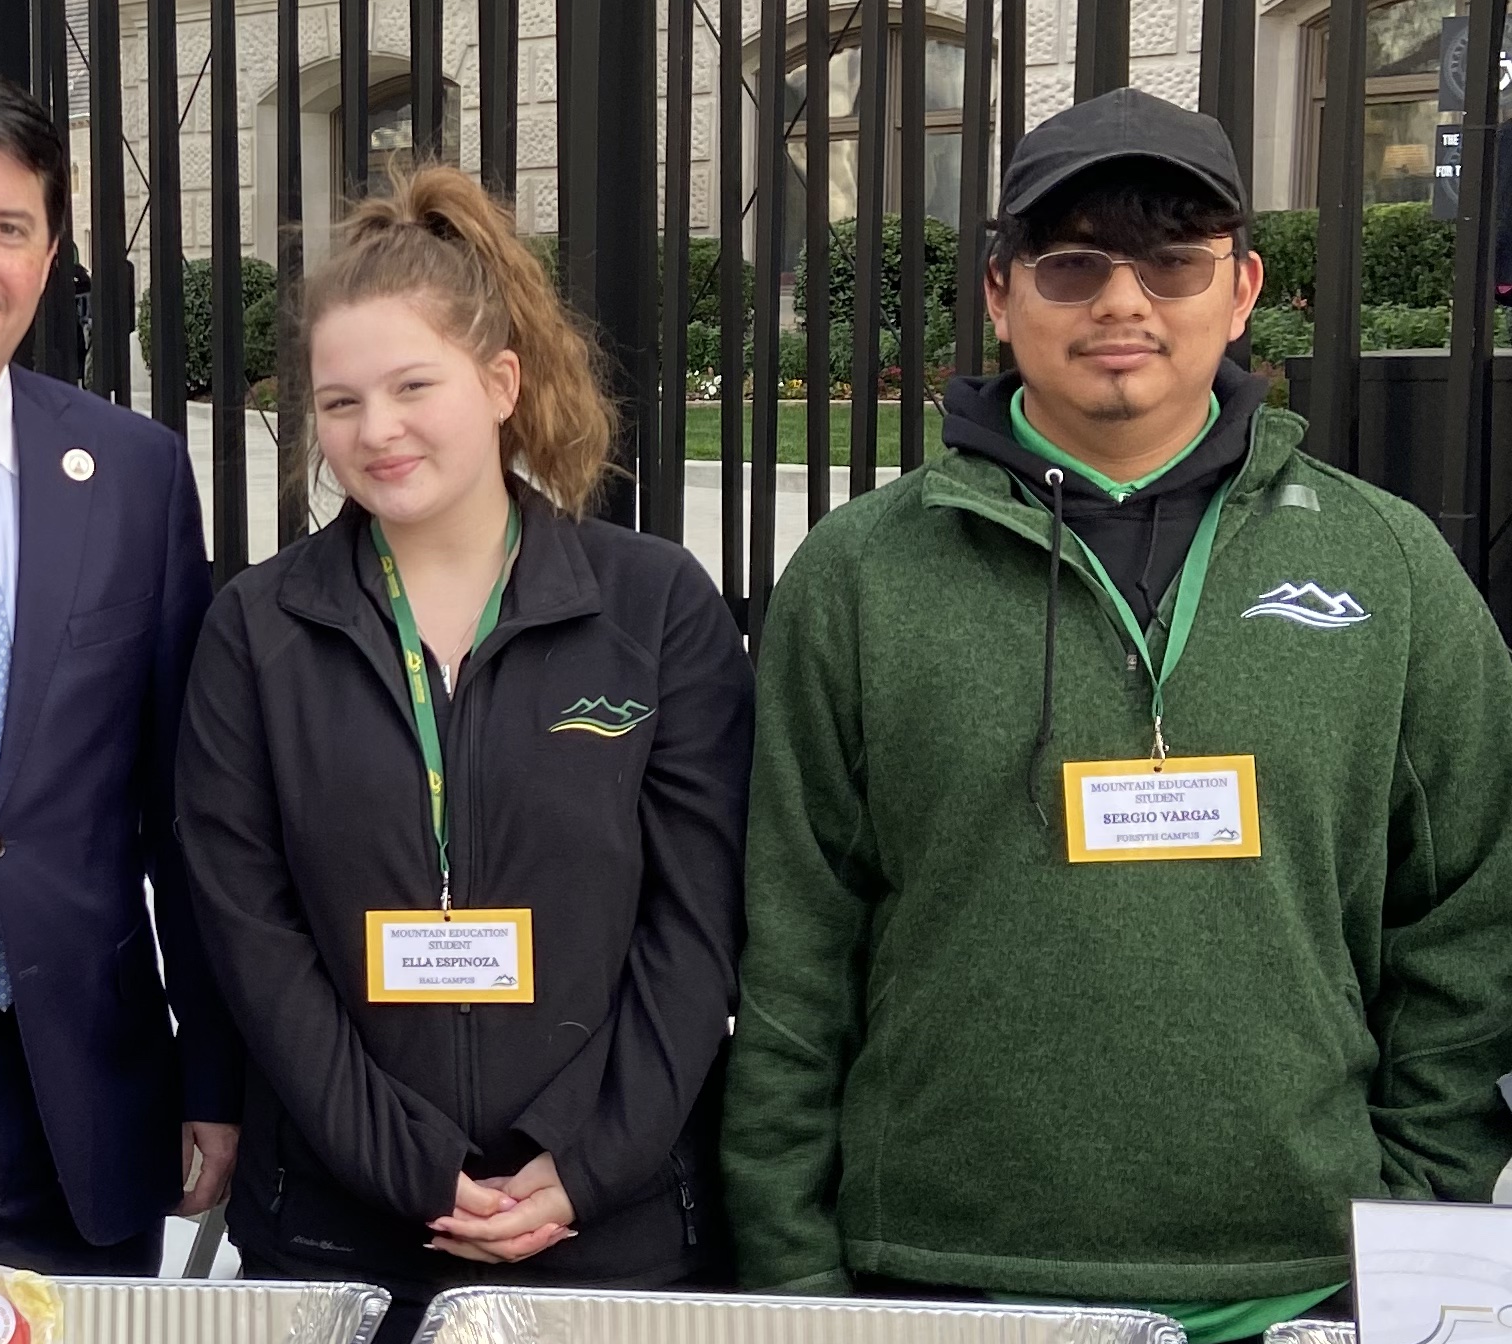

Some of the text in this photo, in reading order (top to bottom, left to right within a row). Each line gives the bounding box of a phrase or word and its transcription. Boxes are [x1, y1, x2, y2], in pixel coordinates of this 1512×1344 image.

[1091, 778, 1228, 793] MOUNTAIN EDUCATION
[1135, 792, 1185, 805] STUDENT
[1103, 809, 1220, 824] SERGIO VARGAS
[390, 928, 509, 938] MOUNTAIN EDUCATION
[428, 940, 472, 950] STUDENT
[402, 957, 500, 968] ELLA ESPINOZA
